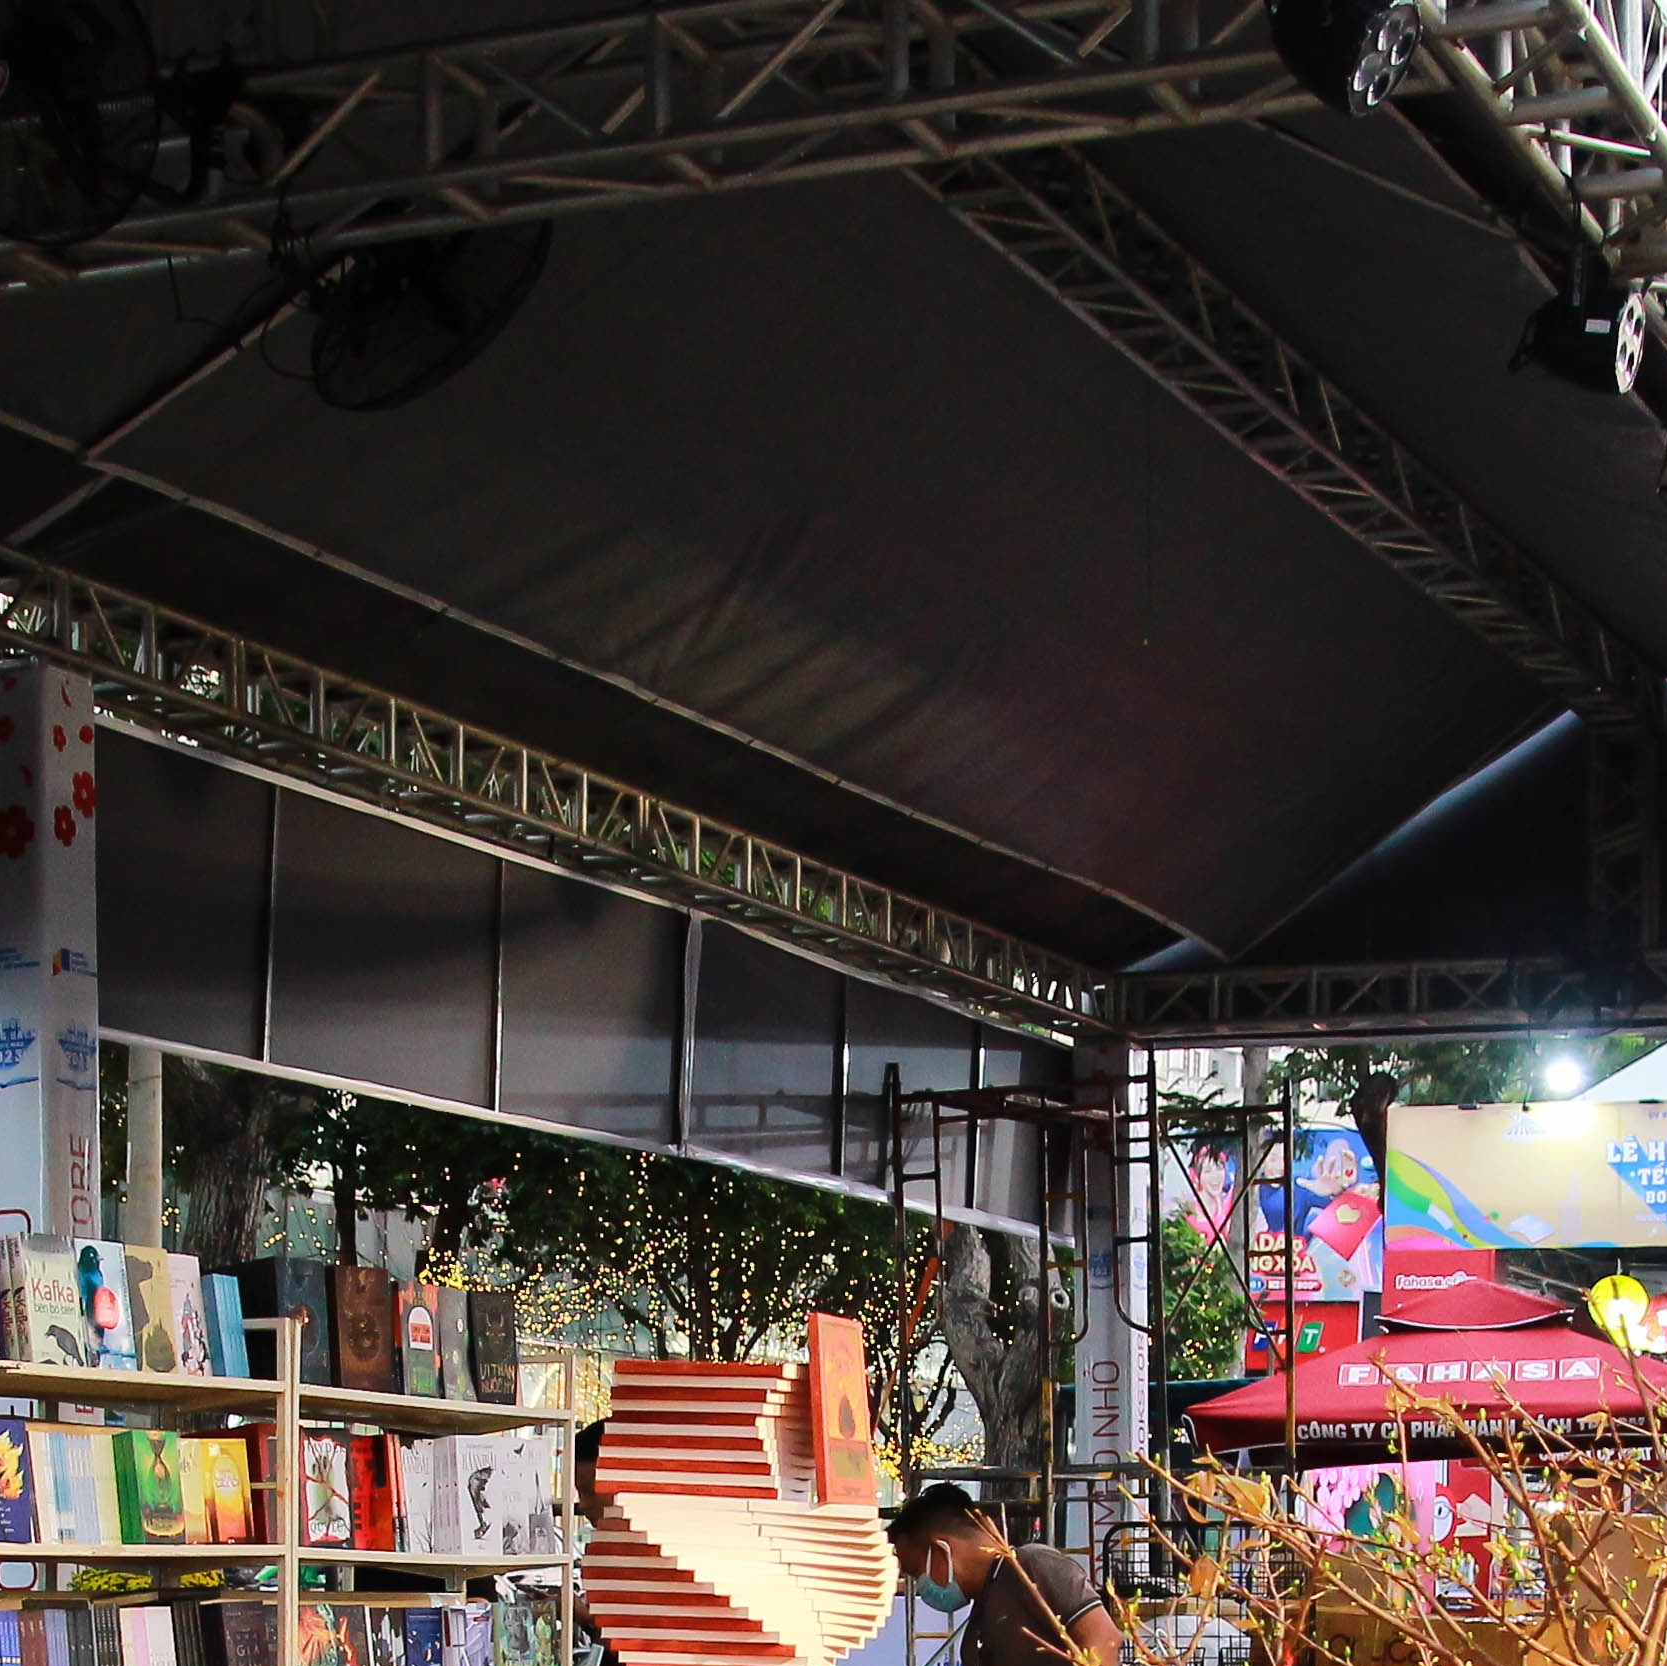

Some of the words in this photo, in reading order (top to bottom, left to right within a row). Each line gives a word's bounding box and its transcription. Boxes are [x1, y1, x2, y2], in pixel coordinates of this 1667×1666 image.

[32, 1278, 74, 1303] Kafka
[1297, 1420, 1347, 1440] CÔNG
[1351, 1421, 1375, 1439] TY
